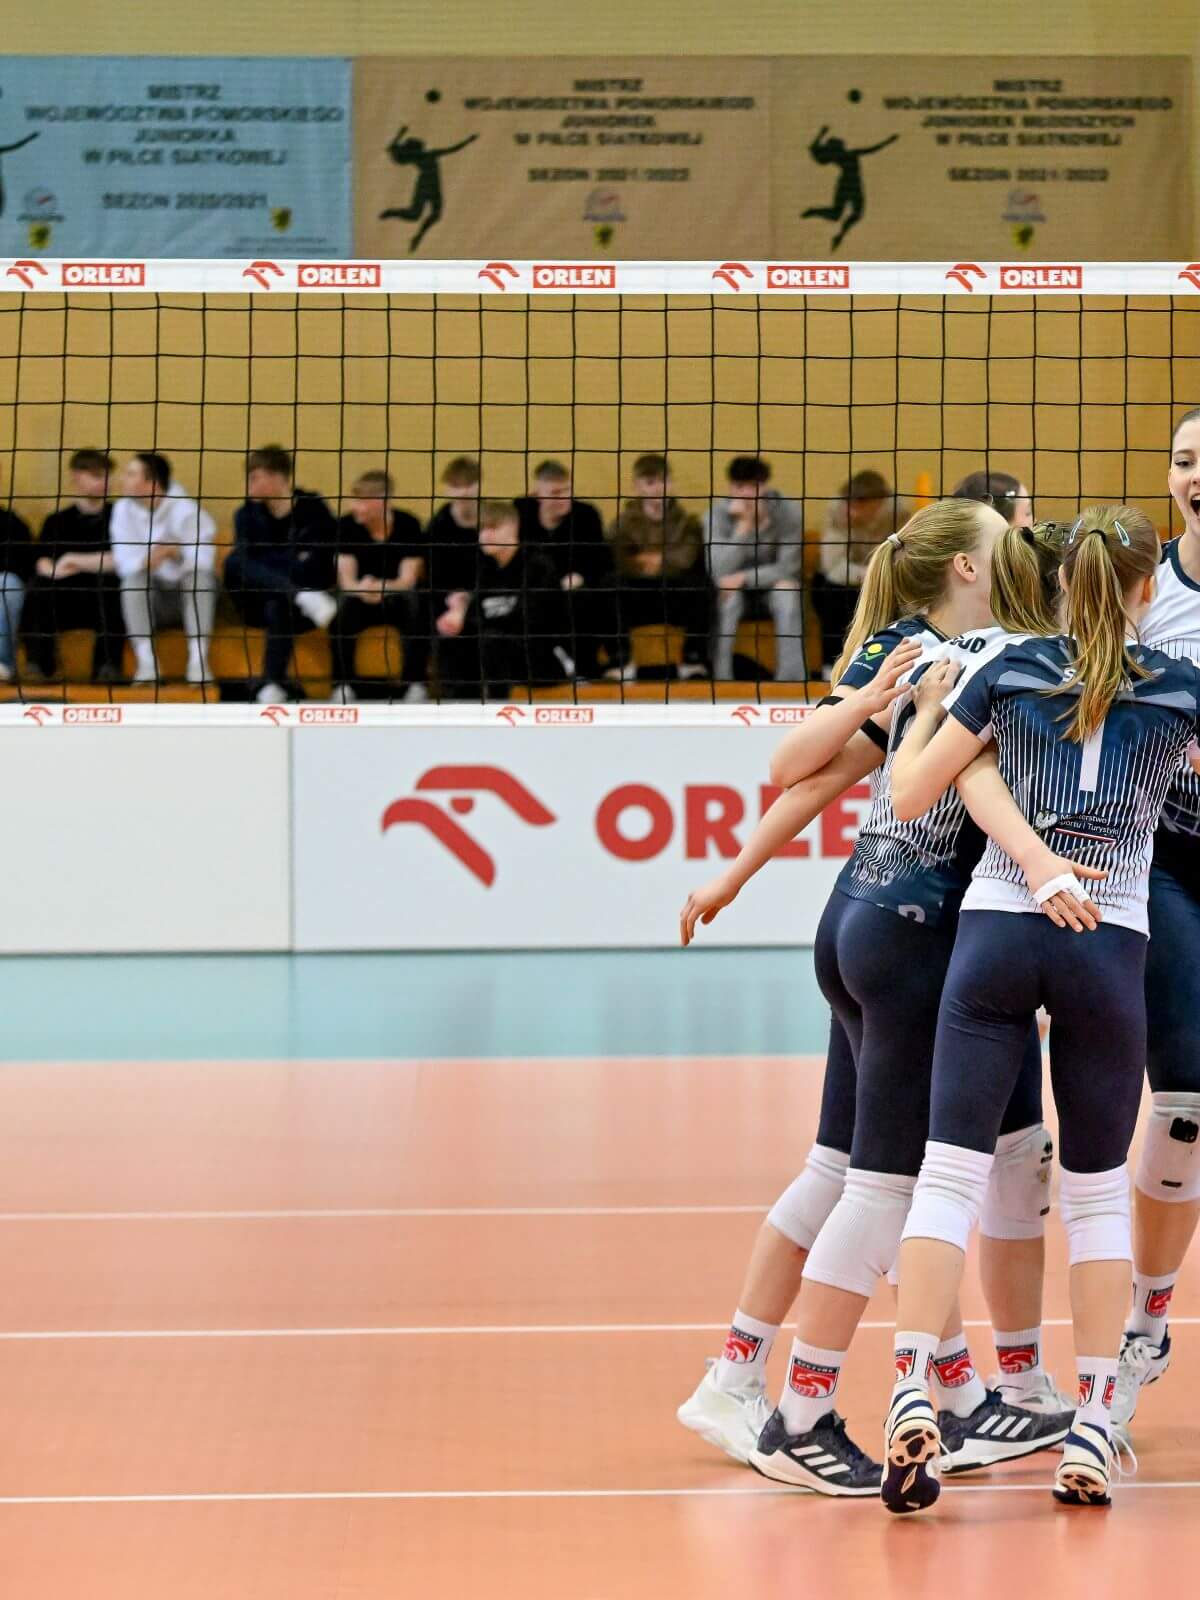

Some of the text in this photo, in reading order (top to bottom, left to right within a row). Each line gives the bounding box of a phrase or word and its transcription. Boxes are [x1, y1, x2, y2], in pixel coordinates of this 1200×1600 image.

[514, 133, 531, 146] W
[936, 133, 951, 146] W
[82, 149, 102, 165] W
[66, 266, 141, 284] ORLEN
[302, 267, 377, 284] ORLEN
[537, 269, 611, 285] ORLEN
[770, 270, 845, 286] ORLEN
[1004, 270, 1078, 286] ORLEN
[65, 710, 120, 722] ORLEN
[302, 710, 356, 722] ORLEN
[537, 709, 591, 722] ORLEN
[772, 710, 814, 721] ORLE
[595, 783, 872, 861] ORE
